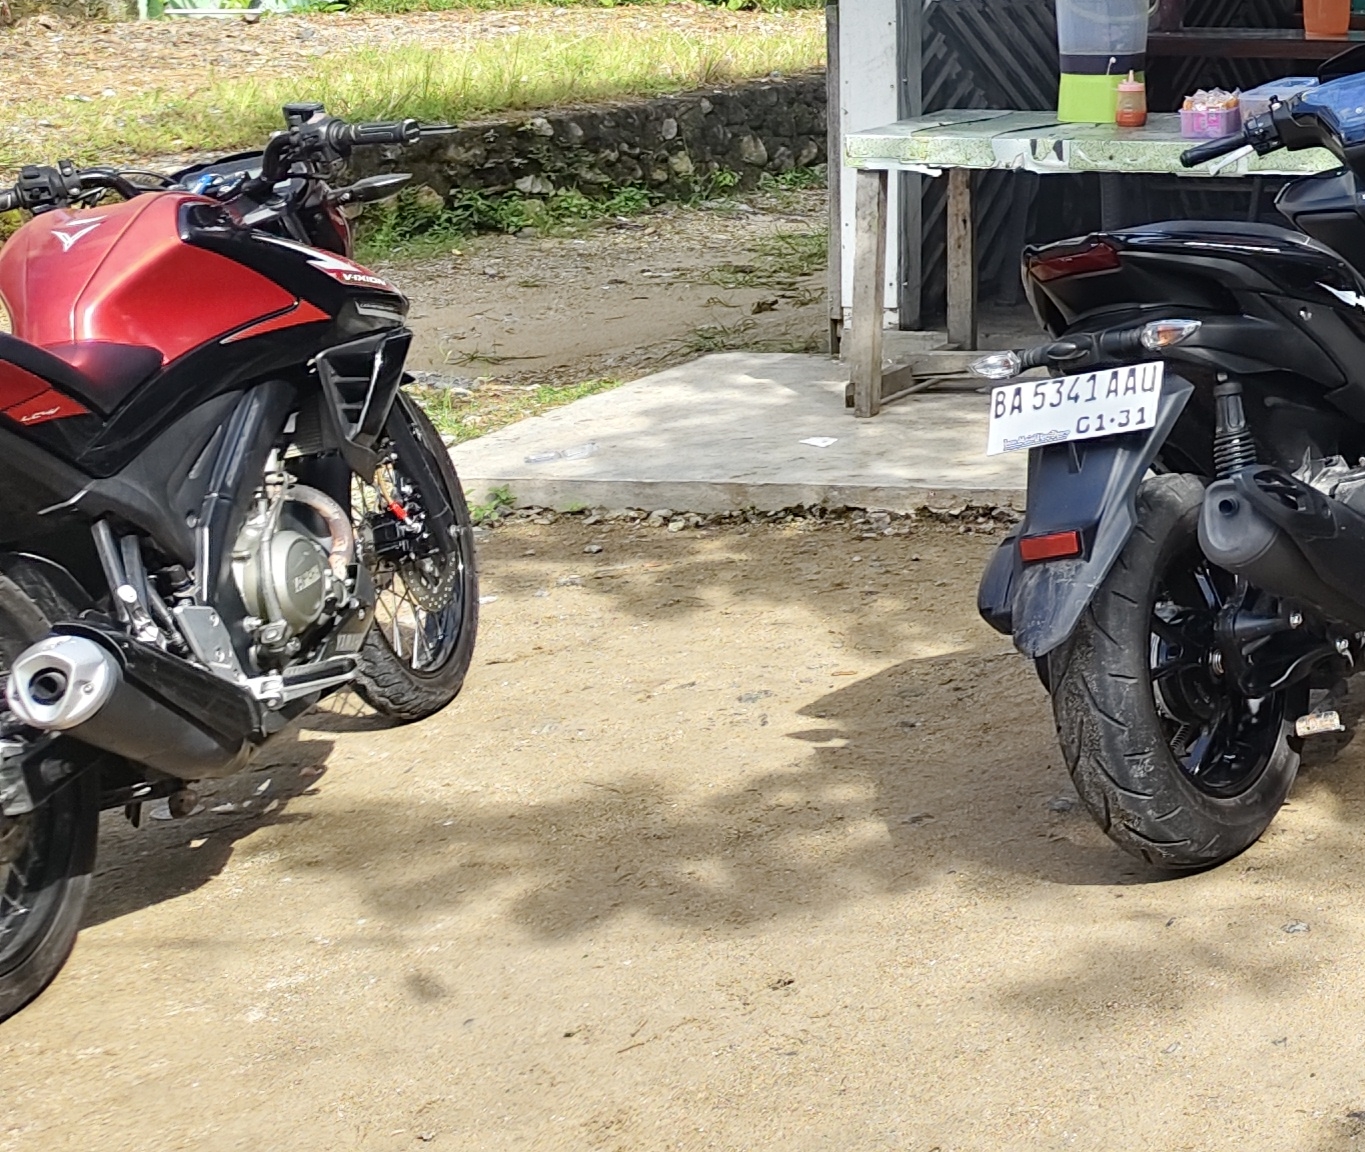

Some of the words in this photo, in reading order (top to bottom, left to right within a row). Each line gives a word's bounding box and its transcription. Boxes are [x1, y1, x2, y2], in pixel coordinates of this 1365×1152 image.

[994, 386, 1023, 419] BA
[1032, 374, 1097, 411] 5341
[1105, 365, 1157, 399] AAU
